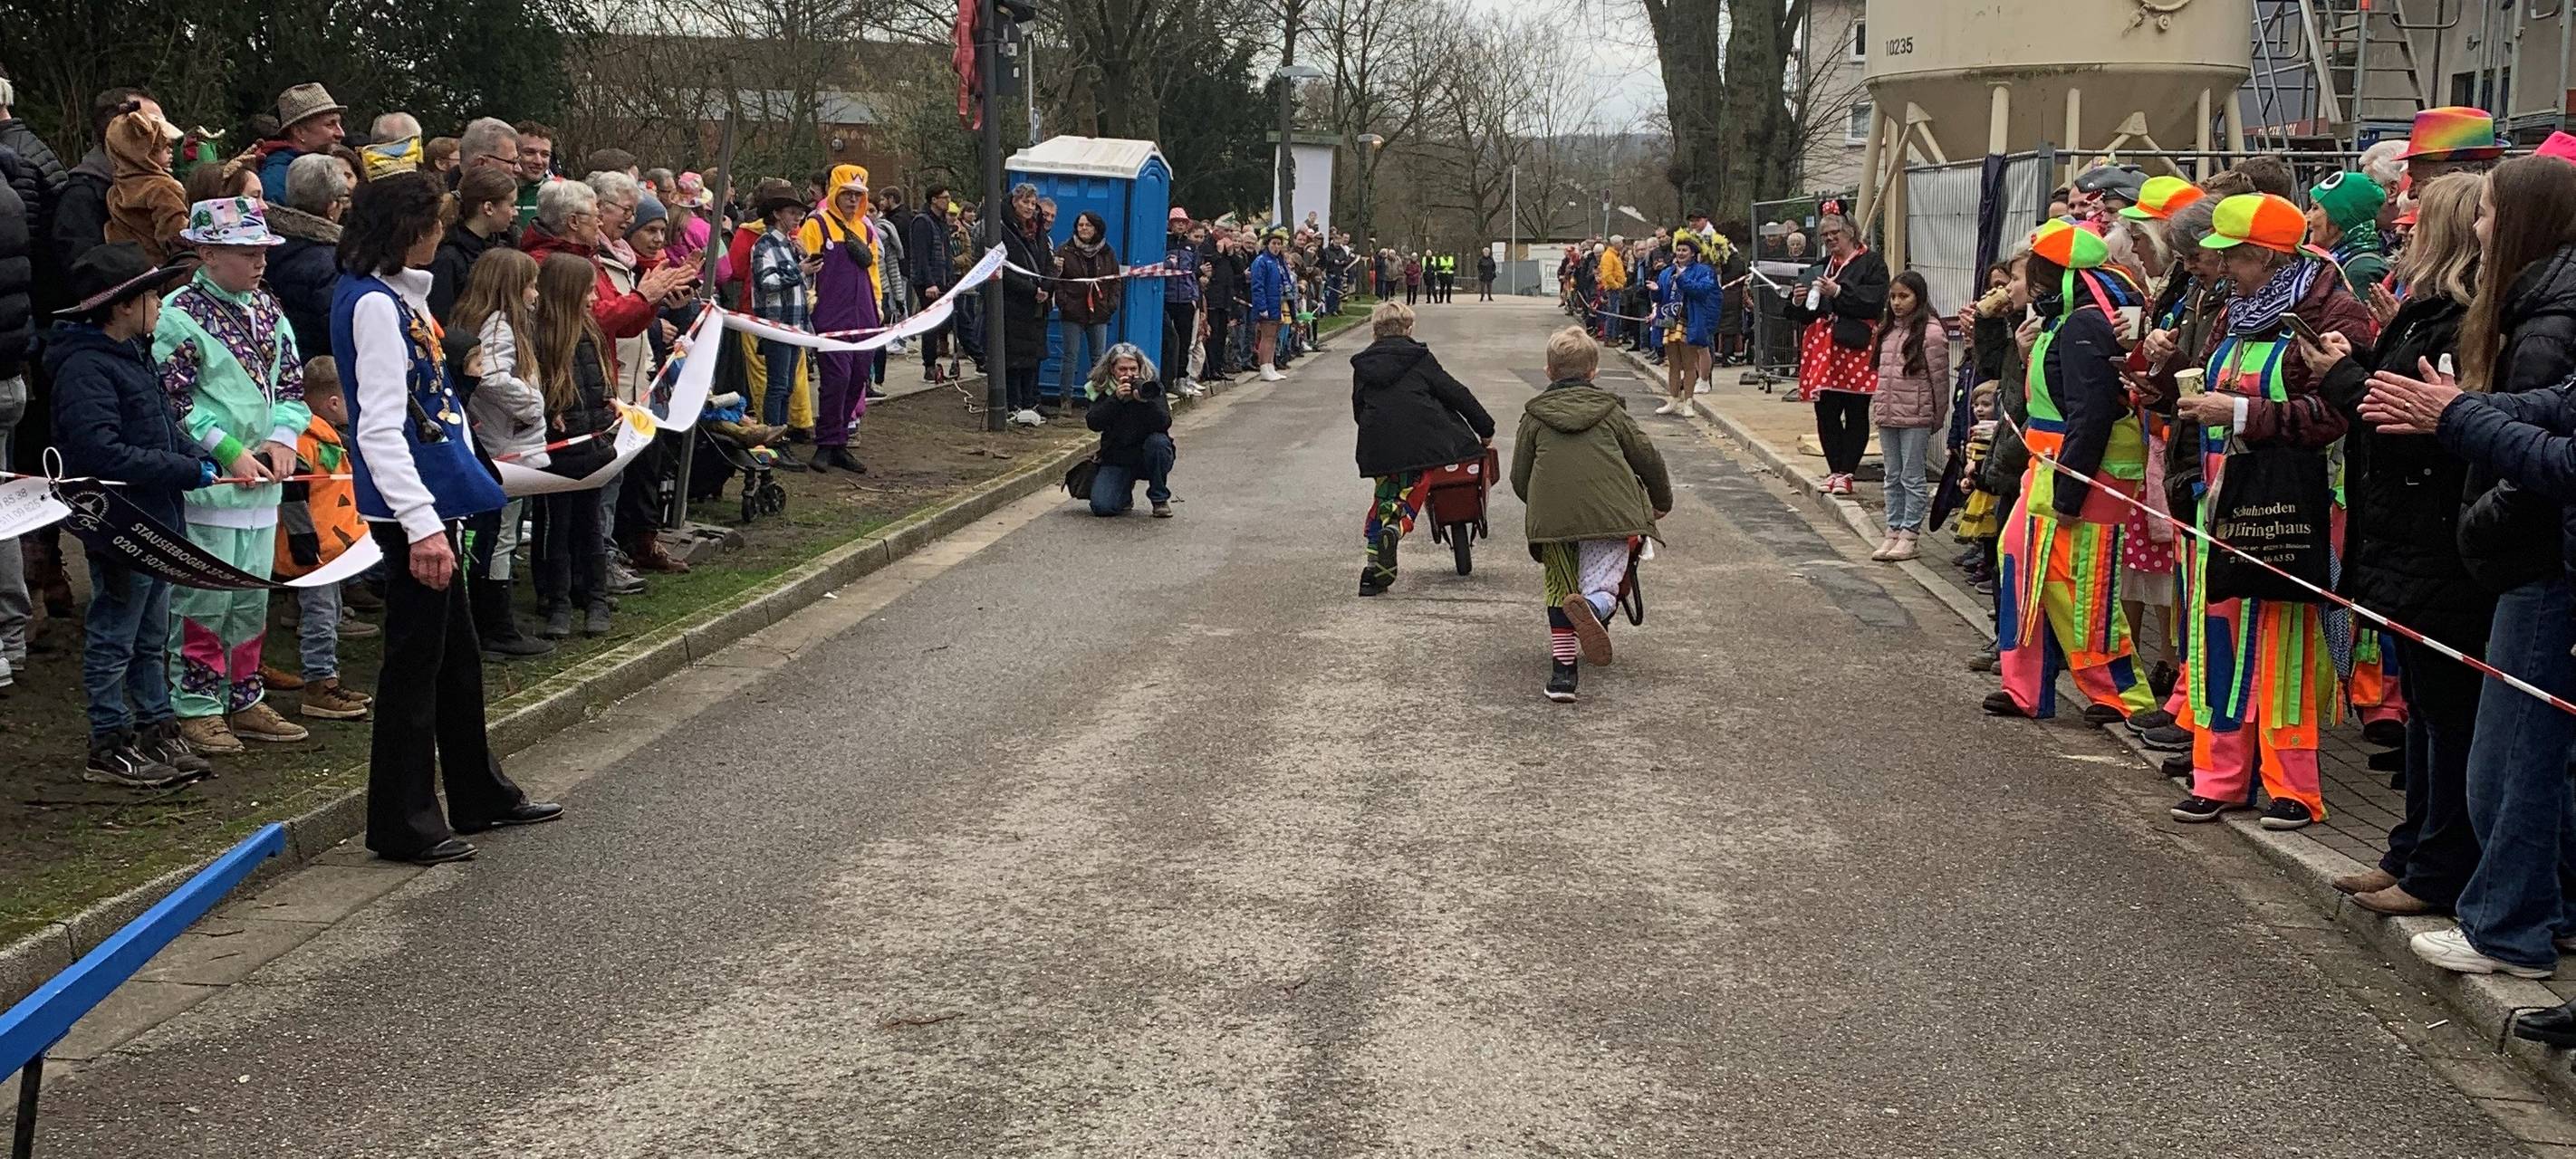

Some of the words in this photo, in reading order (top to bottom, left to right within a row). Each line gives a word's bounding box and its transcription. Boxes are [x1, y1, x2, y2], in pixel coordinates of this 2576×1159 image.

[1885, 36, 1914, 57] 10235
[112, 535, 139, 558] 0201
[130, 522, 211, 573] STAUSEEBOGEN
